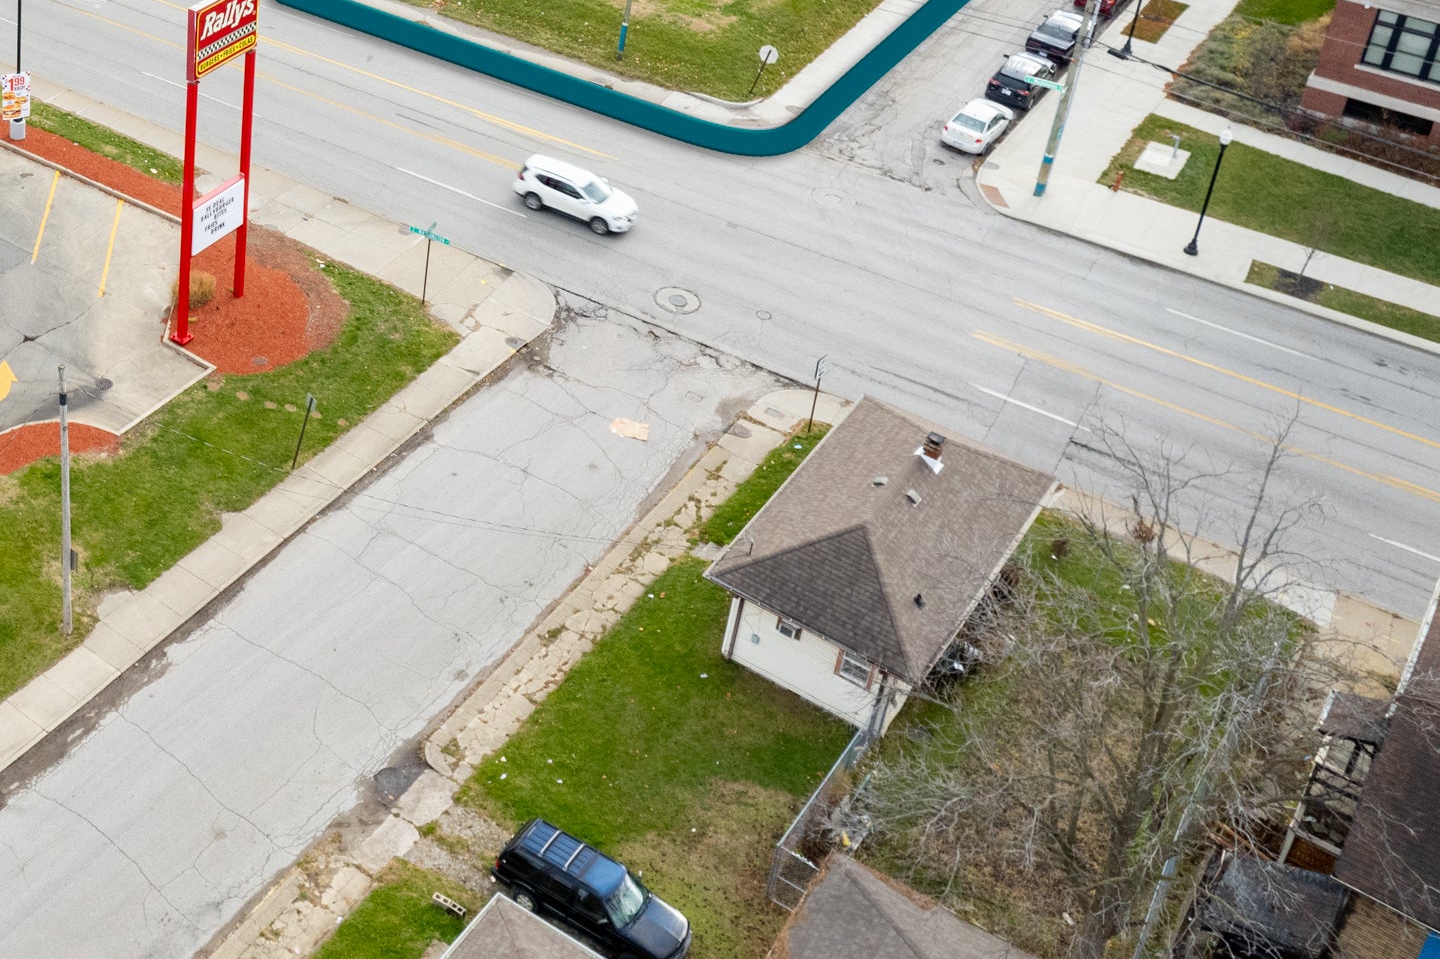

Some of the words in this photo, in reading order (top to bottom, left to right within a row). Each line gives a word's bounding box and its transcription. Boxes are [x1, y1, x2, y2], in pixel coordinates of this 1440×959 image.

[200, 54, 220, 71] BURGERS
[222, 46, 236, 58] FRIES
[239, 36, 254, 49] COLAS
